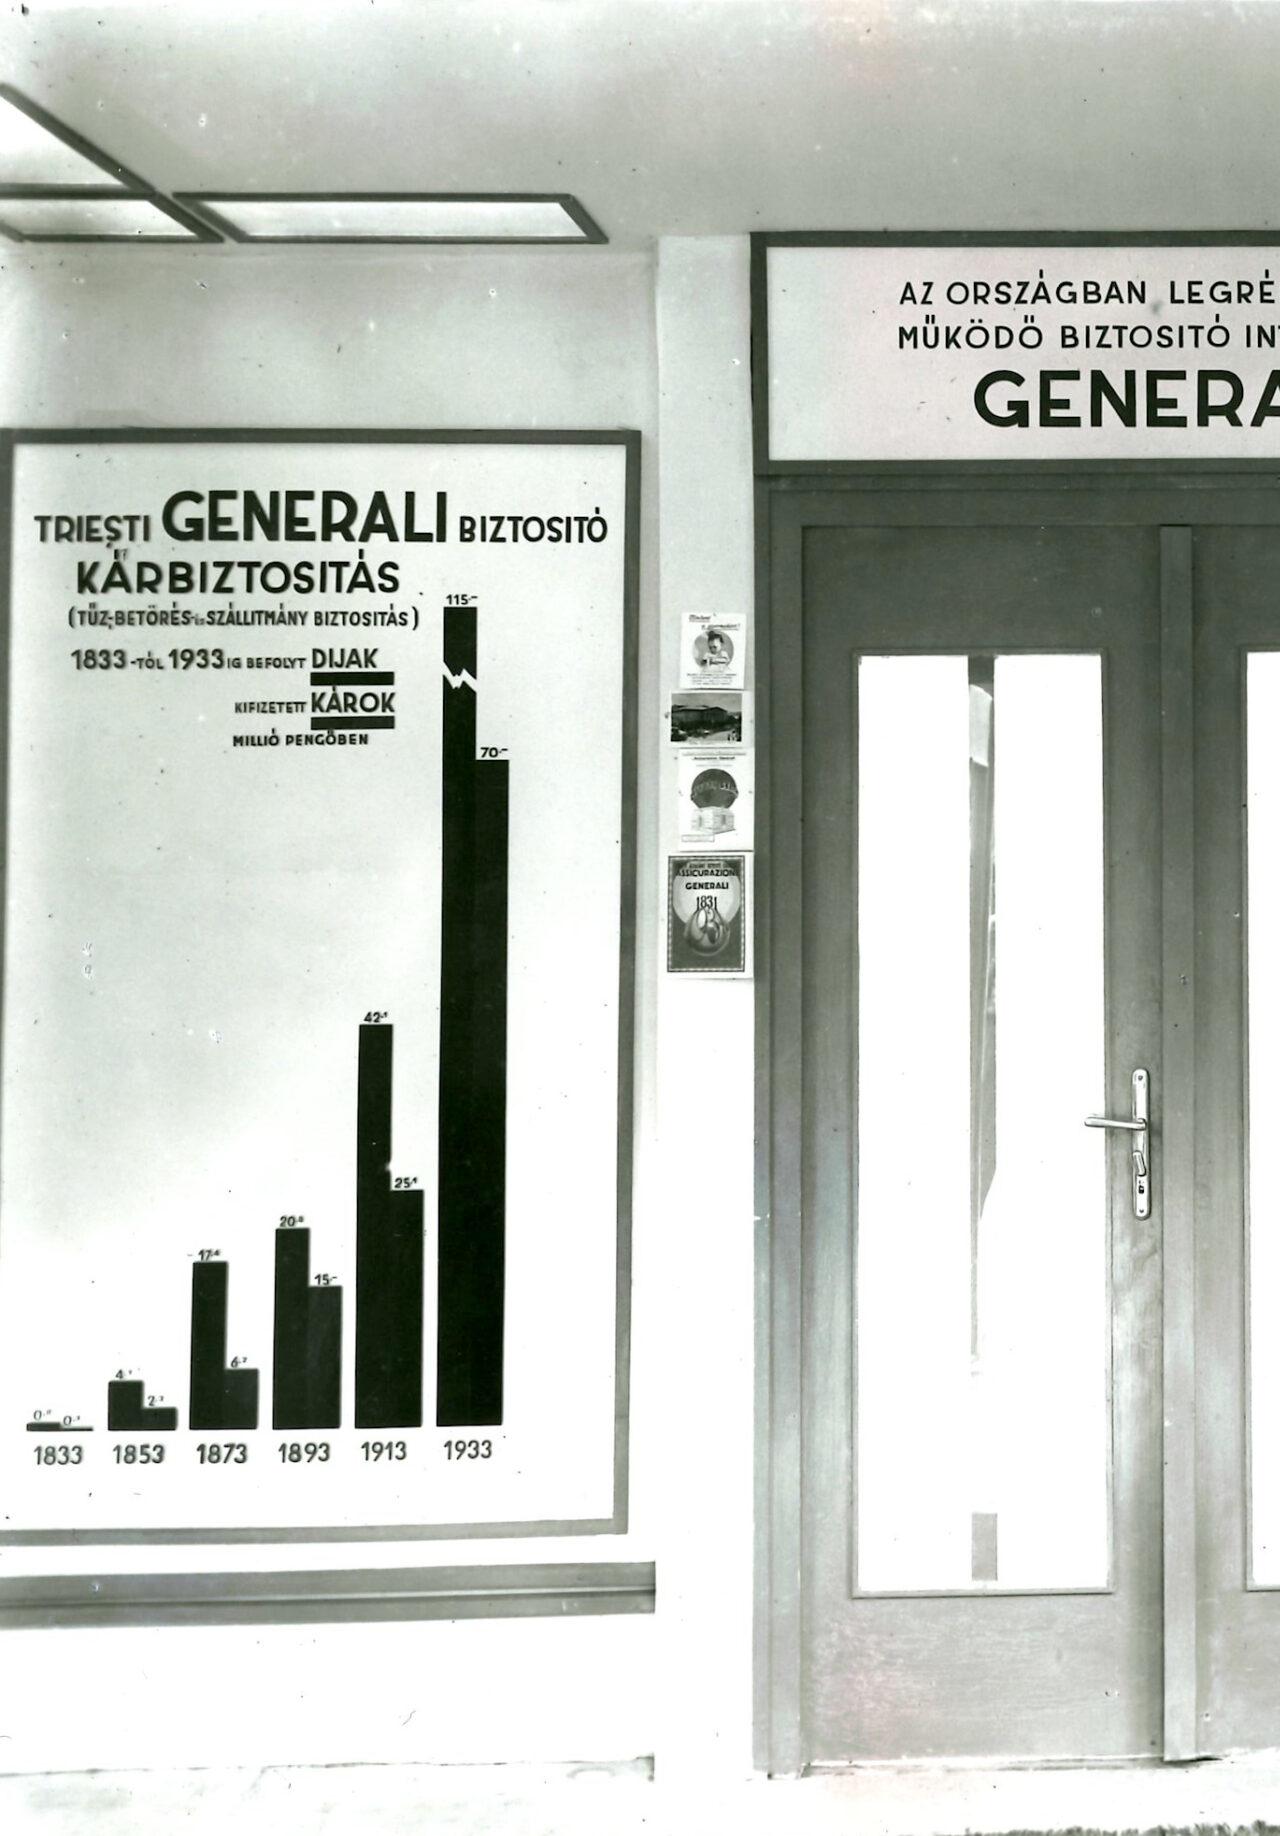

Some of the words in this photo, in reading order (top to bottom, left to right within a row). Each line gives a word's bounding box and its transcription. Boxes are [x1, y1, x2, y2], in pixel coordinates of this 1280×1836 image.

[899, 281, 934, 306] AZ
[946, 268, 1146, 305] ORSZÁGBAN
[1060, 313, 1231, 349] BIZTOSITÓ
[33, 514, 152, 544] TRIESTI
[161, 489, 448, 543] GENERALI
[459, 506, 608, 544] BIZTOSITÓ
[77, 548, 400, 595] KÁRBIZTOSITÁS
[70, 648, 127, 671] 1833
[246, 657, 307, 669] BEFOLYT
[311, 647, 379, 669] DIJAK
[234, 701, 307, 714] KIFIZETETT
[311, 685, 396, 714] KÁROK
[232, 727, 281, 748] MILLIÓ
[684, 881, 729, 891] GENERALI
[33, 1445, 83, 1465] 1833
[113, 1444, 165, 1464] 1853
[196, 1443, 248, 1464] 1873
[277, 1442, 330, 1463] 1893
[360, 1441, 407, 1461] 1913
[443, 1439, 492, 1460] 1933
